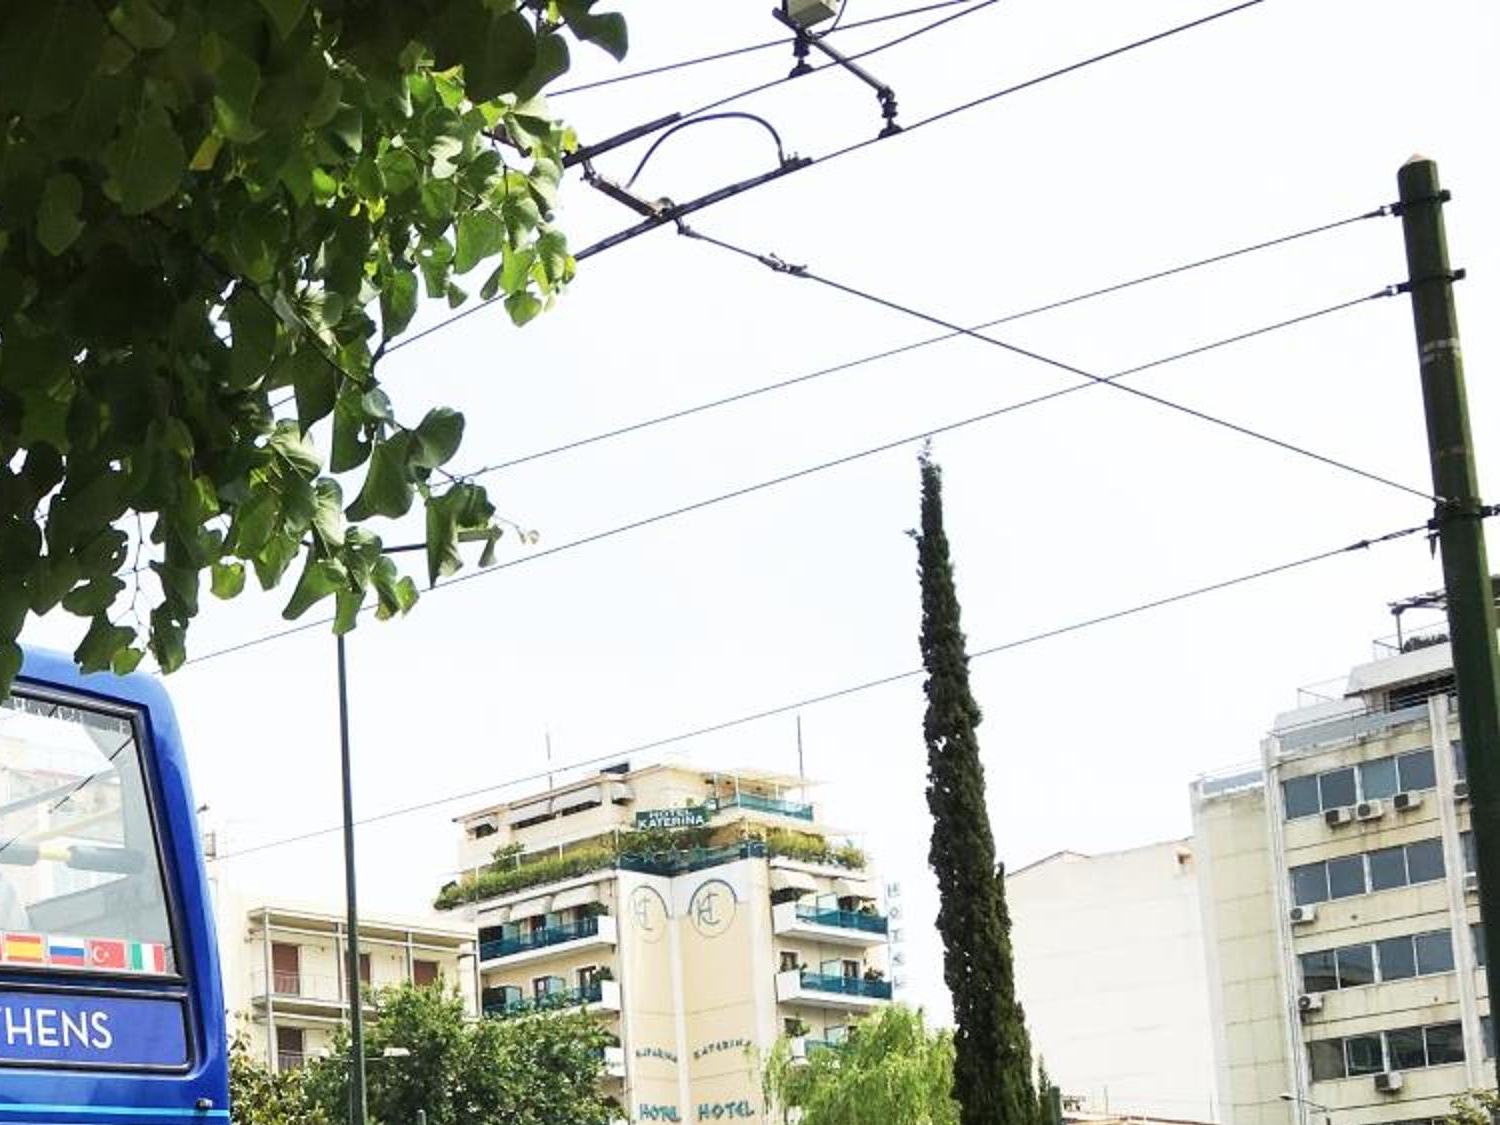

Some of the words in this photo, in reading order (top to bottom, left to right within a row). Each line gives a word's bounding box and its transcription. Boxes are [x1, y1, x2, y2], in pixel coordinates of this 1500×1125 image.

[638, 815, 705, 830] KATERINA
[649, 809, 693, 819] HOTEL
[639, 1103, 683, 1122] HOTEL
[698, 1100, 755, 1122] HOTEL
